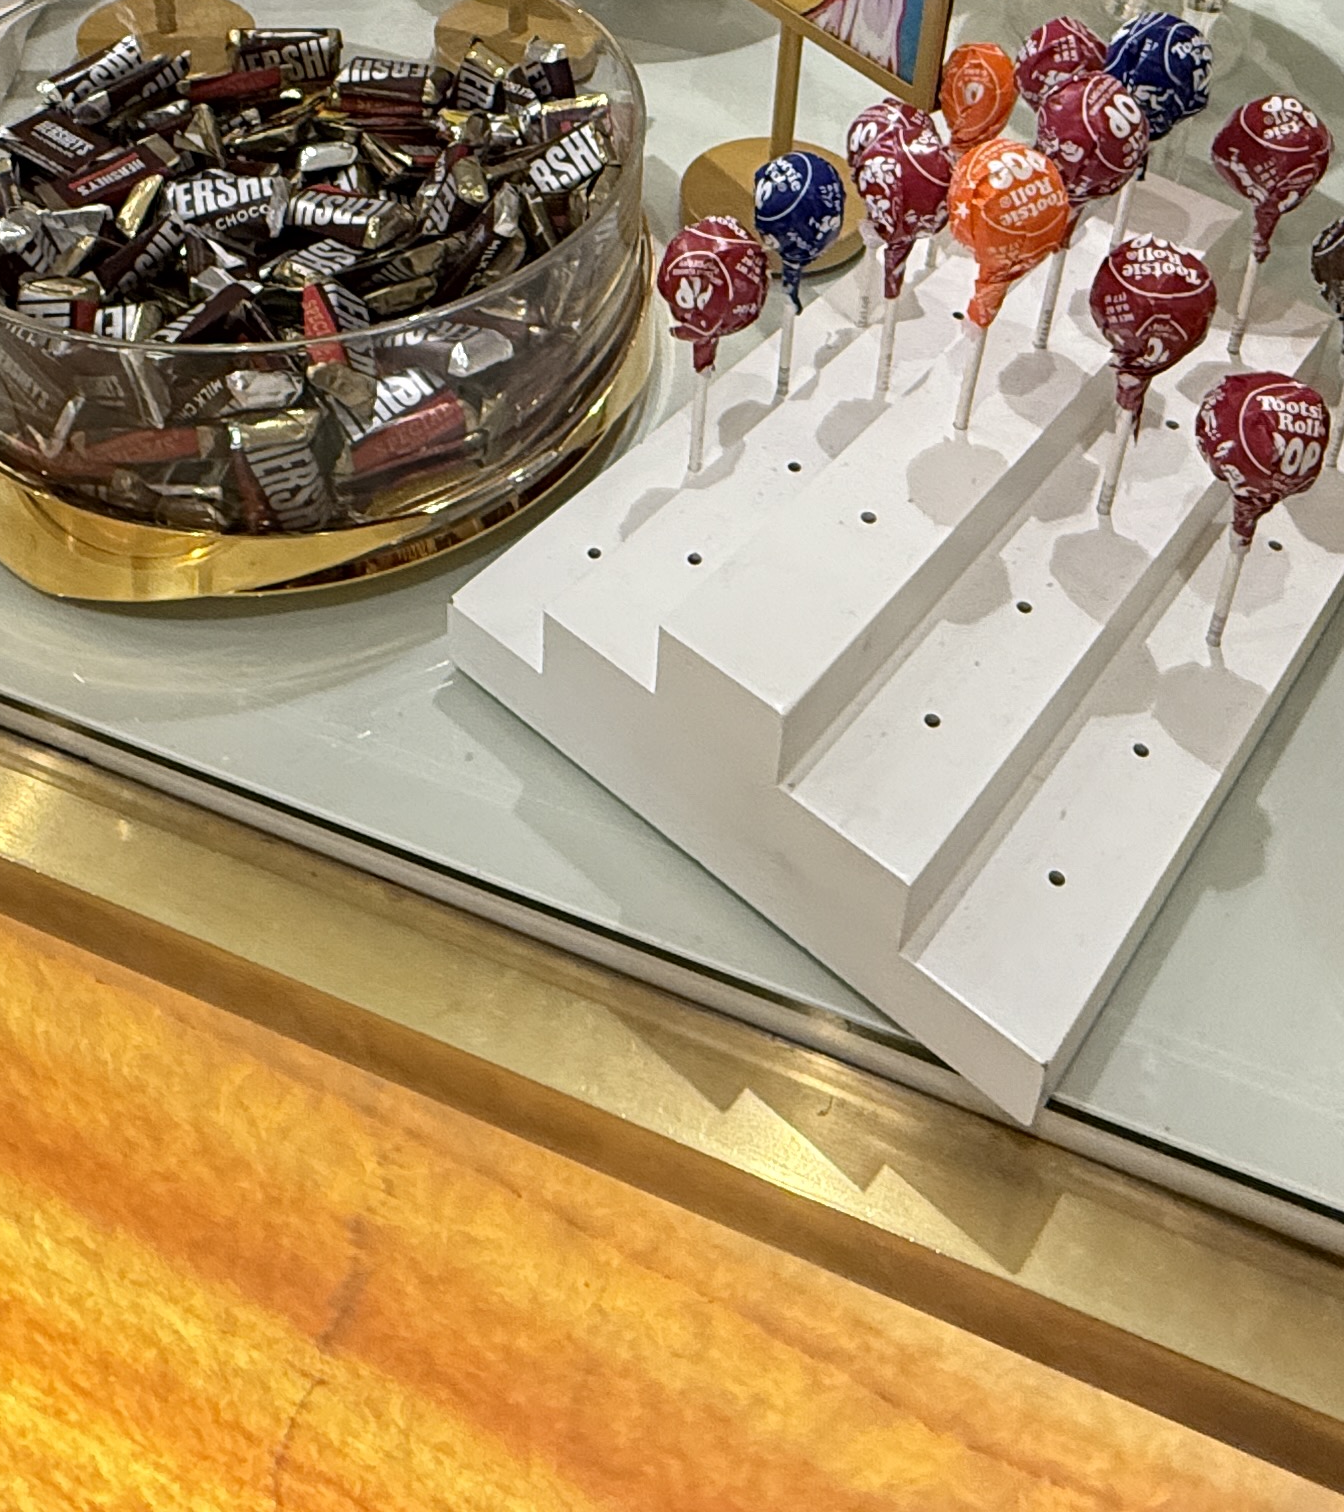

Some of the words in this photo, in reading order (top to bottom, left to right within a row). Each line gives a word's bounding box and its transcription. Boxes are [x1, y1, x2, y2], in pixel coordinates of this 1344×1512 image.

[1105, 94, 1142, 139] OP
[1010, 176, 1054, 203] Roll
[999, 190, 1069, 226] Tootsie
[1121, 262, 1202, 286] Tootsie
[1256, 395, 1324, 420] Tootsi
[1278, 412, 1322, 438] Roll
